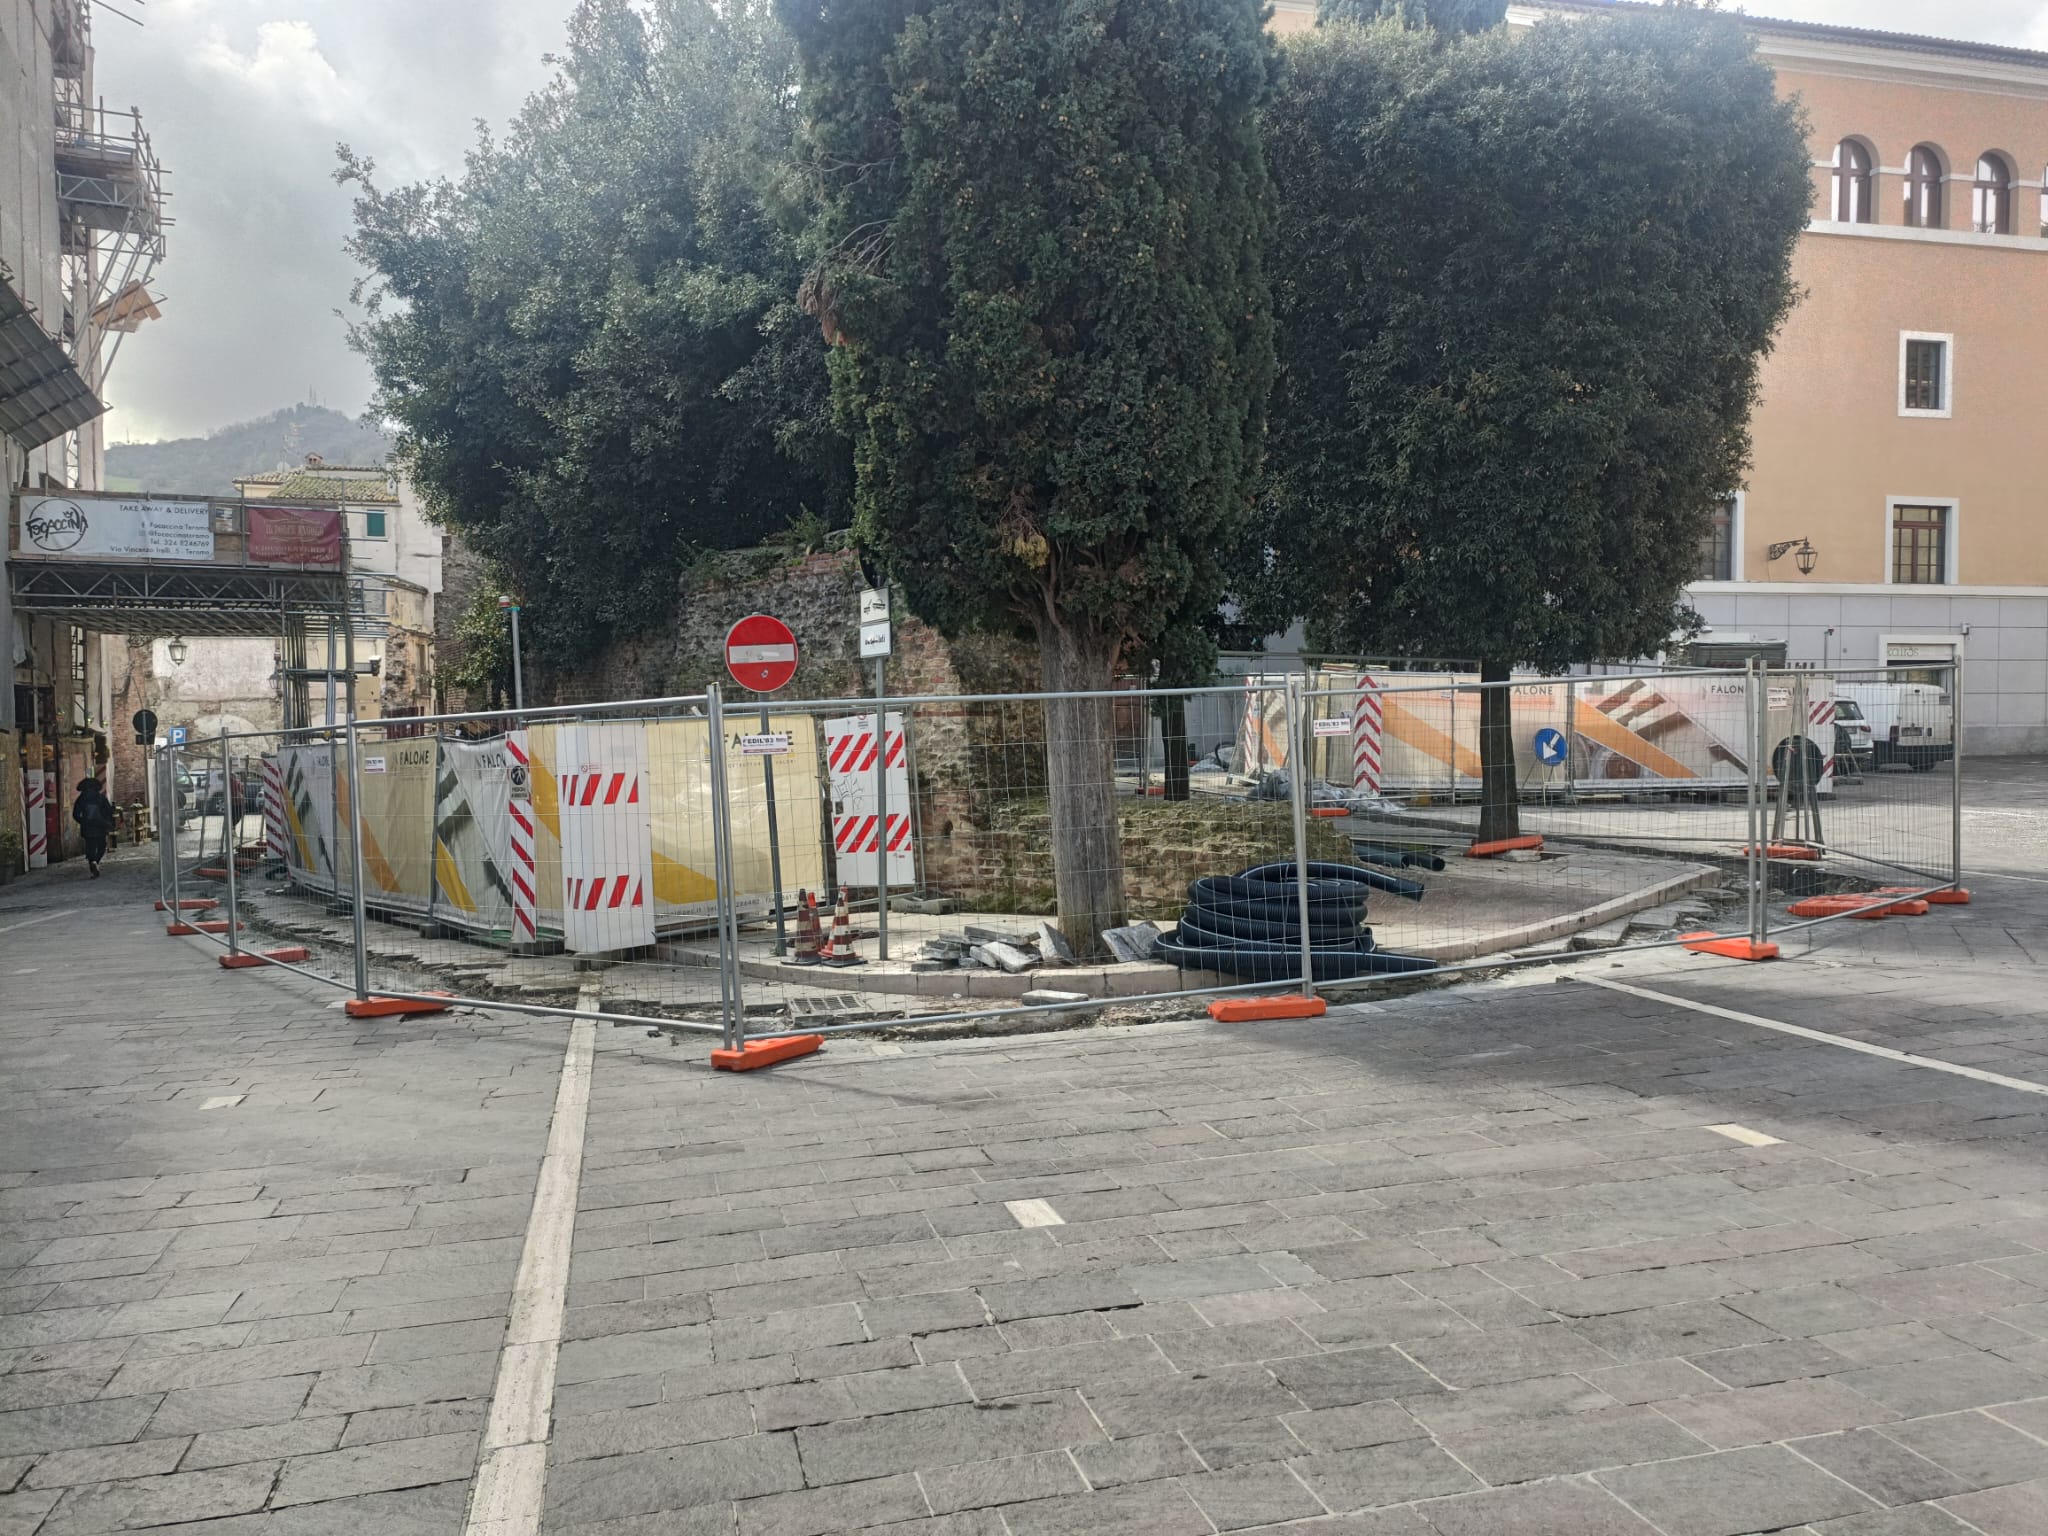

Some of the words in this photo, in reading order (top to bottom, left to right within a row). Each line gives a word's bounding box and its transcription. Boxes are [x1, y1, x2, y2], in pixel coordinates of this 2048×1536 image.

[175, 507, 209, 515] DELIVERY
[1514, 685, 1553, 696] ALONE
[1711, 685, 1745, 694] FALON
[173, 730, 183, 743] P
[399, 750, 430, 766] FALONE
[481, 752, 507, 769] FALON
